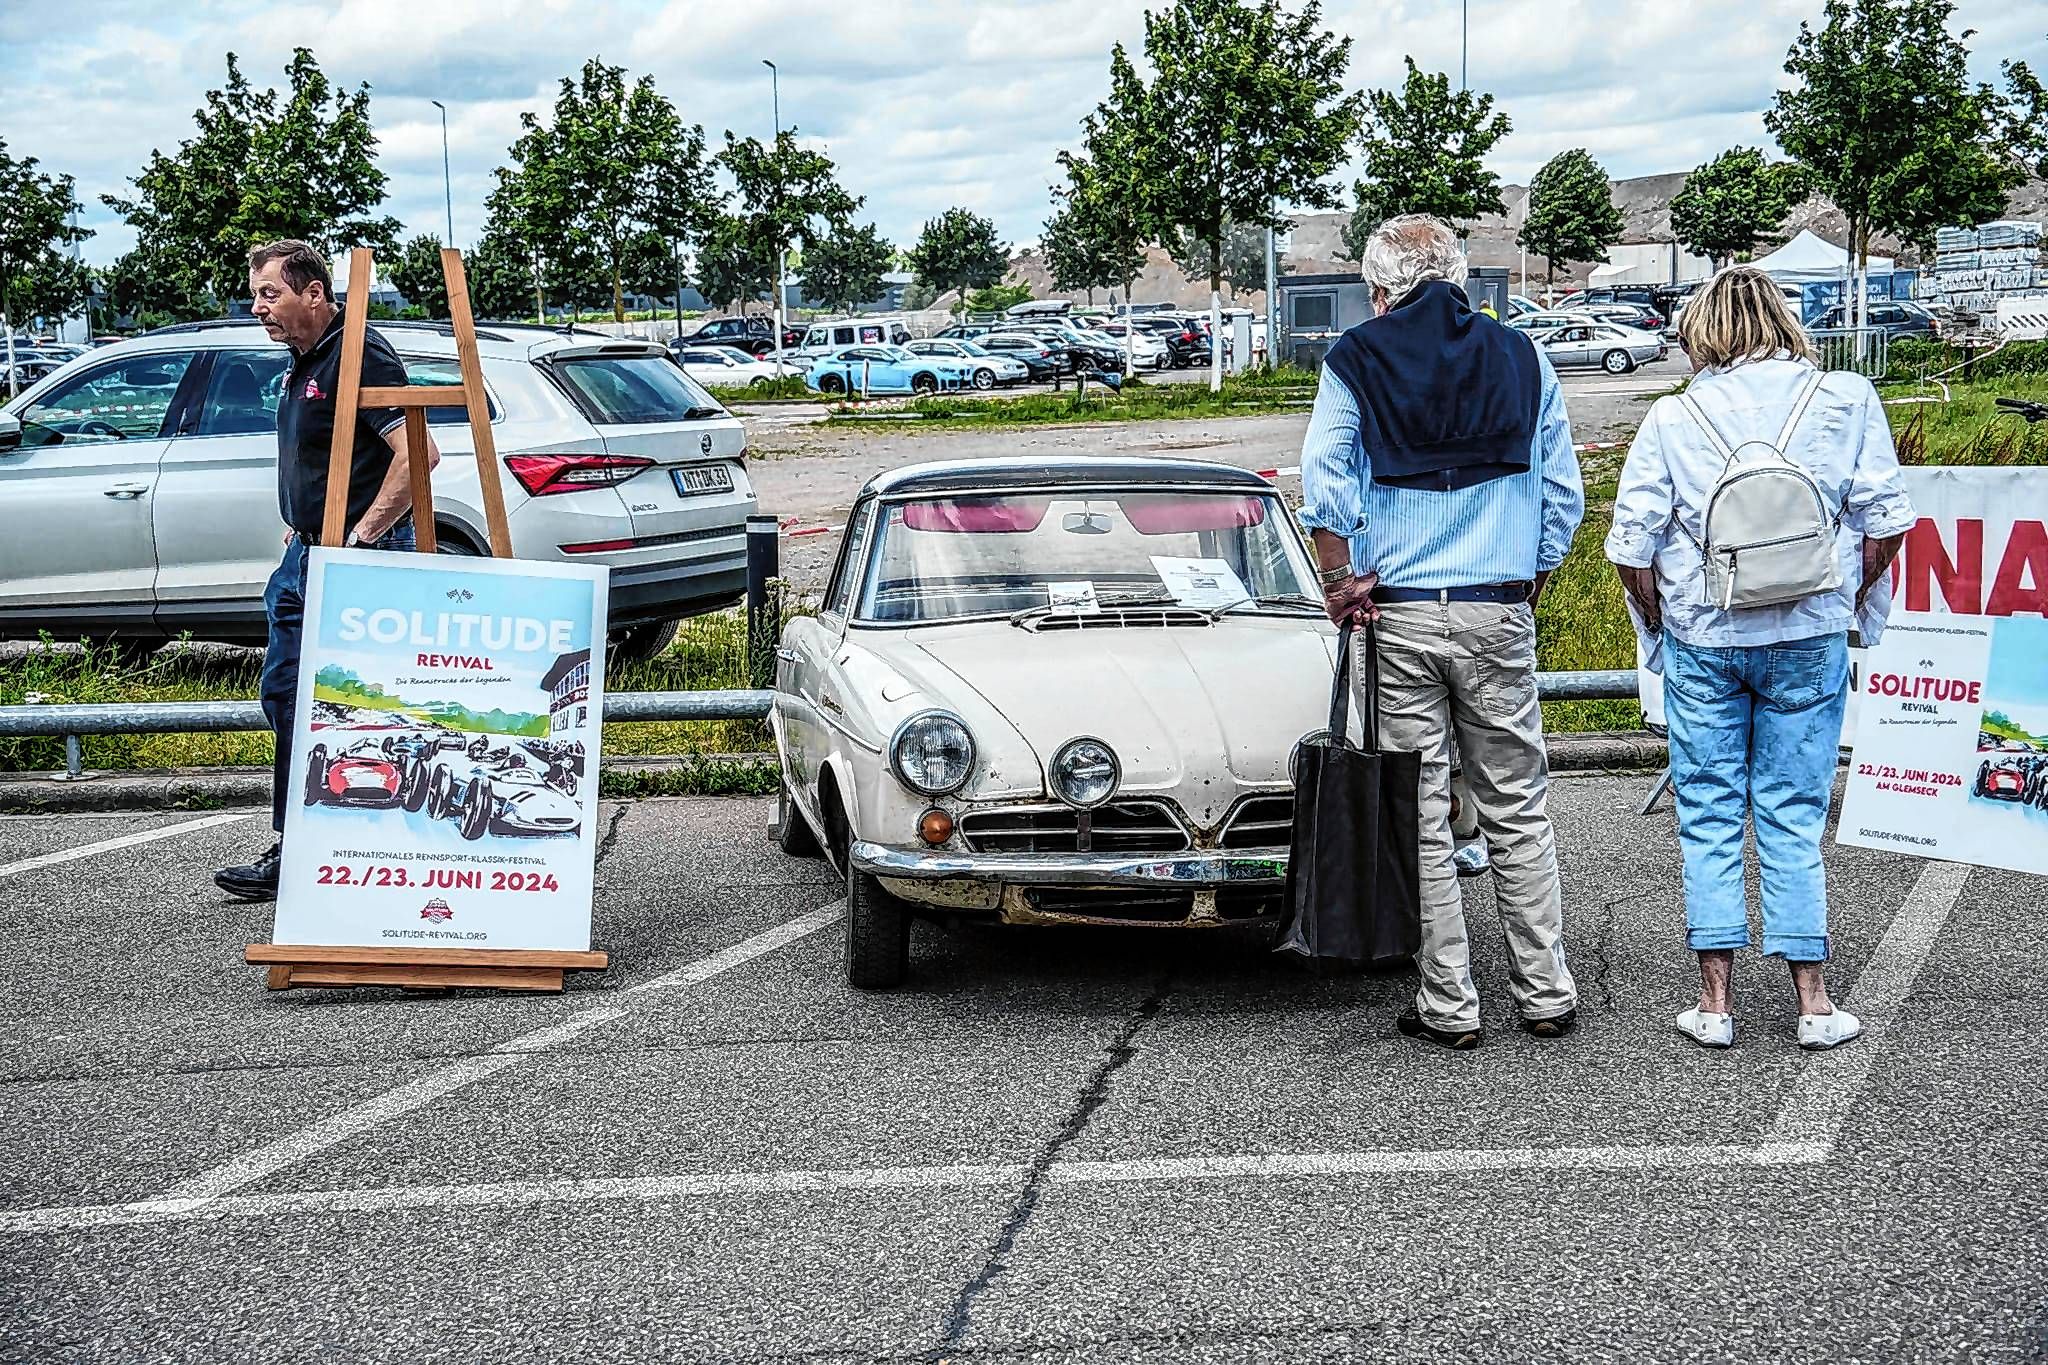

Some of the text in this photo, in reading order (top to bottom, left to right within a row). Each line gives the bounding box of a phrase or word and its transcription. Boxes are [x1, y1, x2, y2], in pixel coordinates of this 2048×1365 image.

[1890, 517, 2048, 618] NA
[338, 607, 575, 653] SOLITUDE
[416, 653, 494, 670] REVIVAL
[1868, 673, 1981, 704] SOLITUDE
[1901, 702, 1938, 714] REVIVAL
[1858, 764, 1962, 787] 22./23. JUNI 2024
[1876, 781, 1938, 797] AM GLEMSECK
[1859, 828, 1938, 847] SOLITUDE-REVIVAL.ORG
[333, 850, 547, 866] INTERNATIONALES RENNSPORT-KLASSIK-FESTIVAL
[317, 865, 559, 892] 22./23. JUNI 2024
[382, 930, 488, 941] SOLITUDE-REVIVAL.ORG
